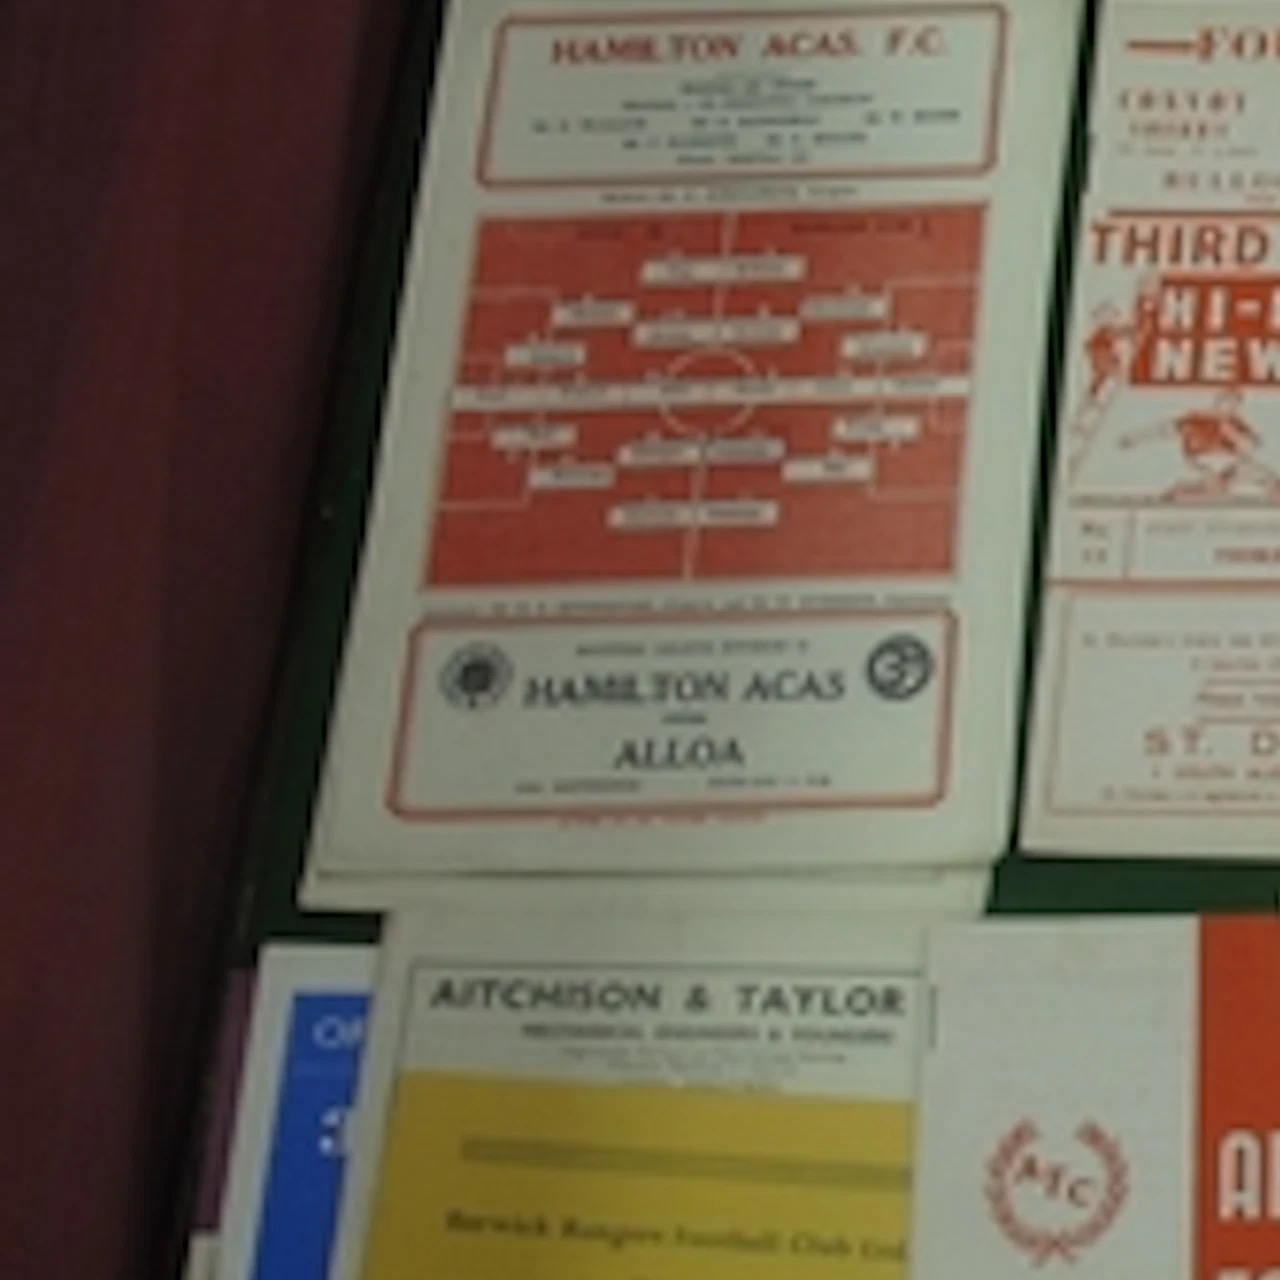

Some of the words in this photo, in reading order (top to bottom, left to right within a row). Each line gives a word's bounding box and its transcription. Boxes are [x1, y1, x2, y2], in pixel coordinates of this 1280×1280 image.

[551, 33, 742, 67] HAMILTON
[1089, 223, 1270, 266] THIRD
[522, 669, 731, 710] HAMILTON
[742, 668, 846, 702] ACAS
[612, 735, 746, 771] ALLOA
[1143, 727, 1216, 759] ST.
[430, 977, 662, 1015] AITCHISON
[684, 986, 711, 1012] &
[735, 984, 906, 1018] TAYLOR
[445, 1208, 550, 1237] Berwick
[559, 1215, 664, 1251] Rangers
[674, 1224, 779, 1253] Football
